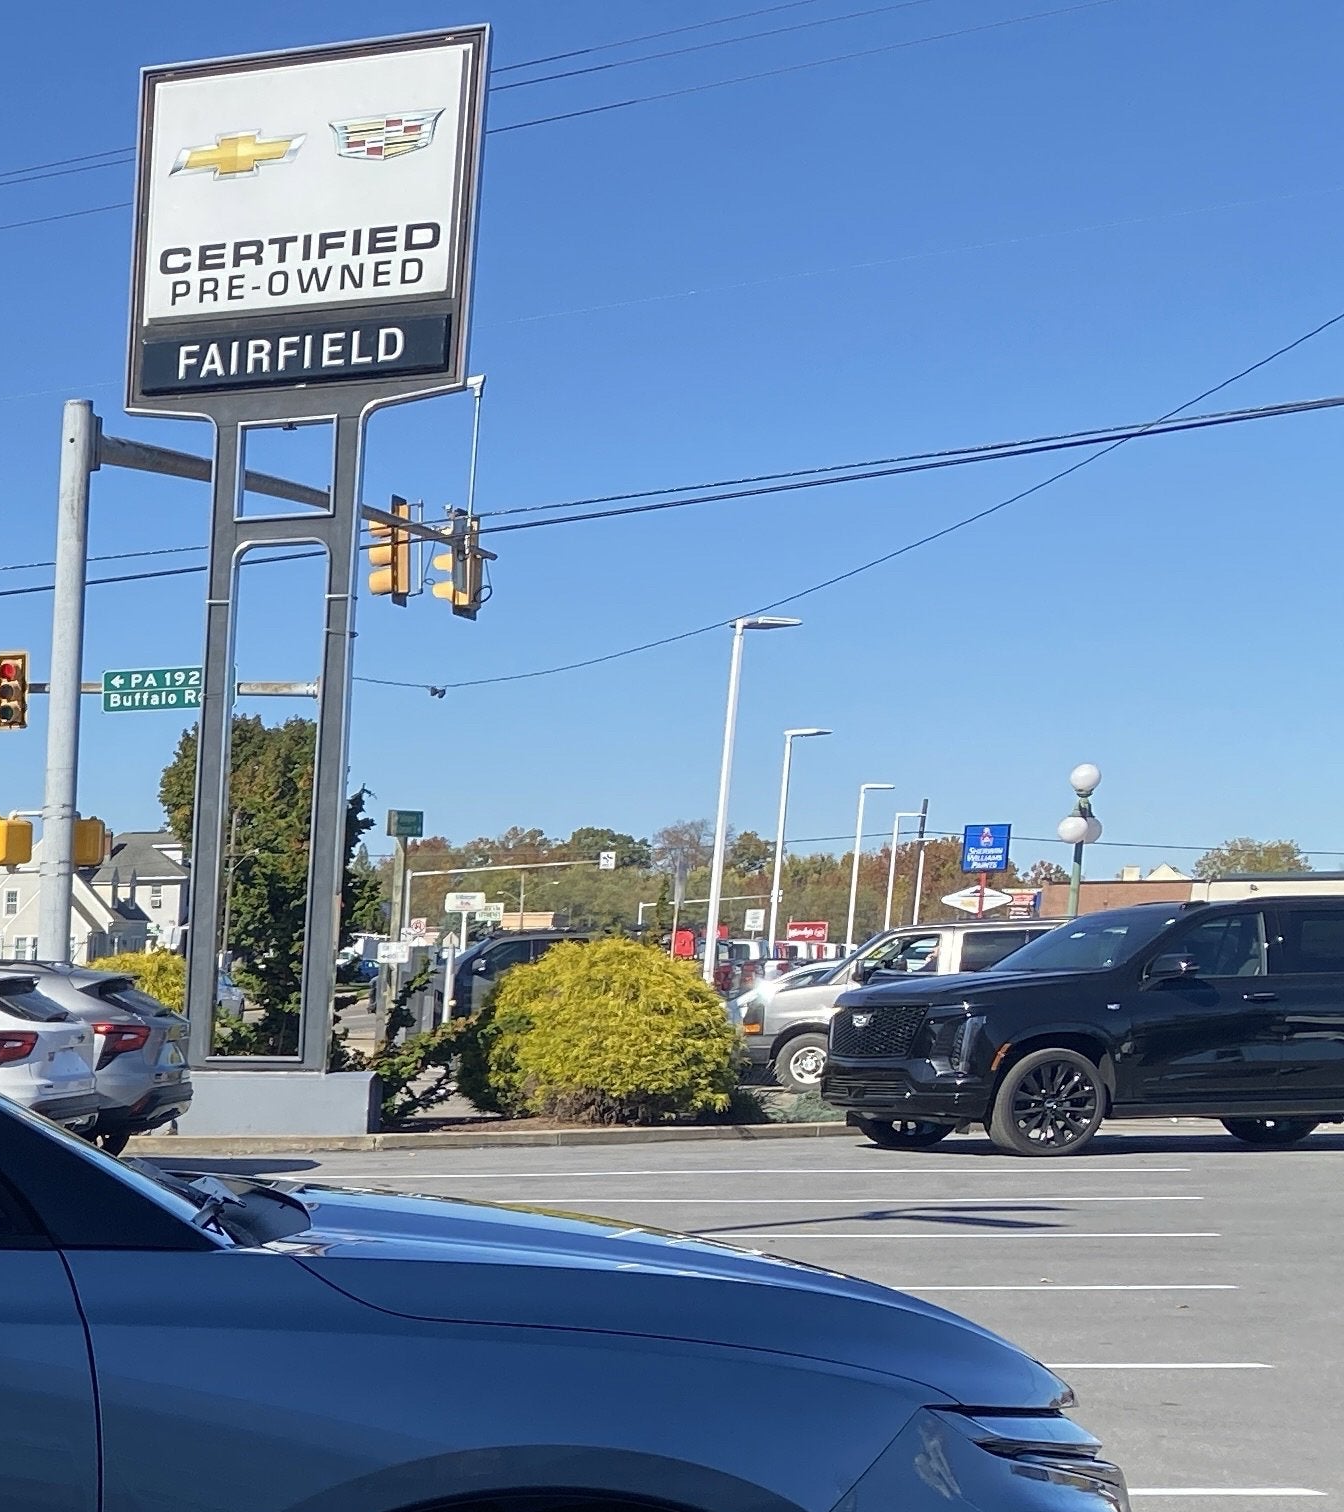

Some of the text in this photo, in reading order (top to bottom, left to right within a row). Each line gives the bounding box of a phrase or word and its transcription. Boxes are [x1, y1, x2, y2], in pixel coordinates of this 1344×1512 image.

[159, 222, 441, 275] CERTIFIED
[171, 257, 424, 306] PRE-OWNED
[177, 326, 406, 381] FAIRFIELD
[110, 691, 177, 707] Buffalo
[131, 671, 200, 688] PA 192
